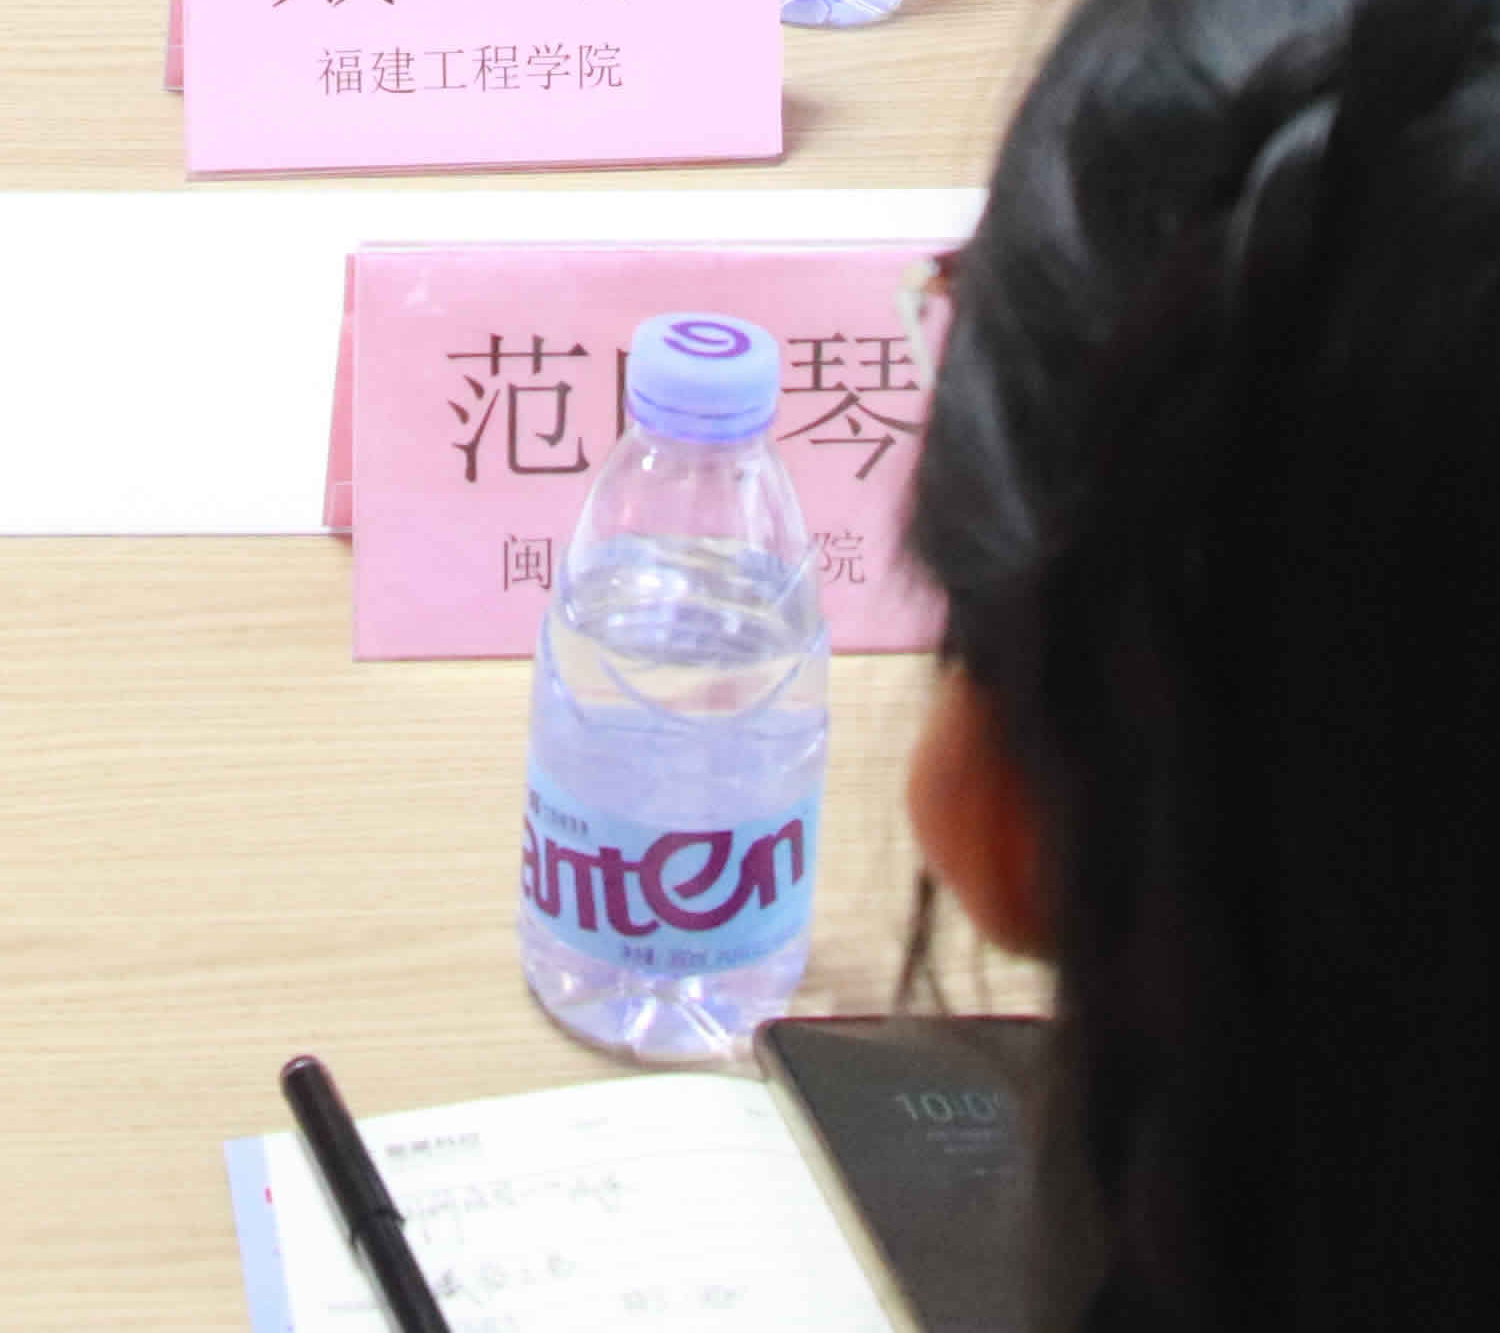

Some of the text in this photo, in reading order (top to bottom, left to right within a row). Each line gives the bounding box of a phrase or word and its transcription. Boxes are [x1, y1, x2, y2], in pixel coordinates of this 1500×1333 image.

[317, 41, 624, 96] 福建工程学院
[445, 331, 926, 483] 范琴
